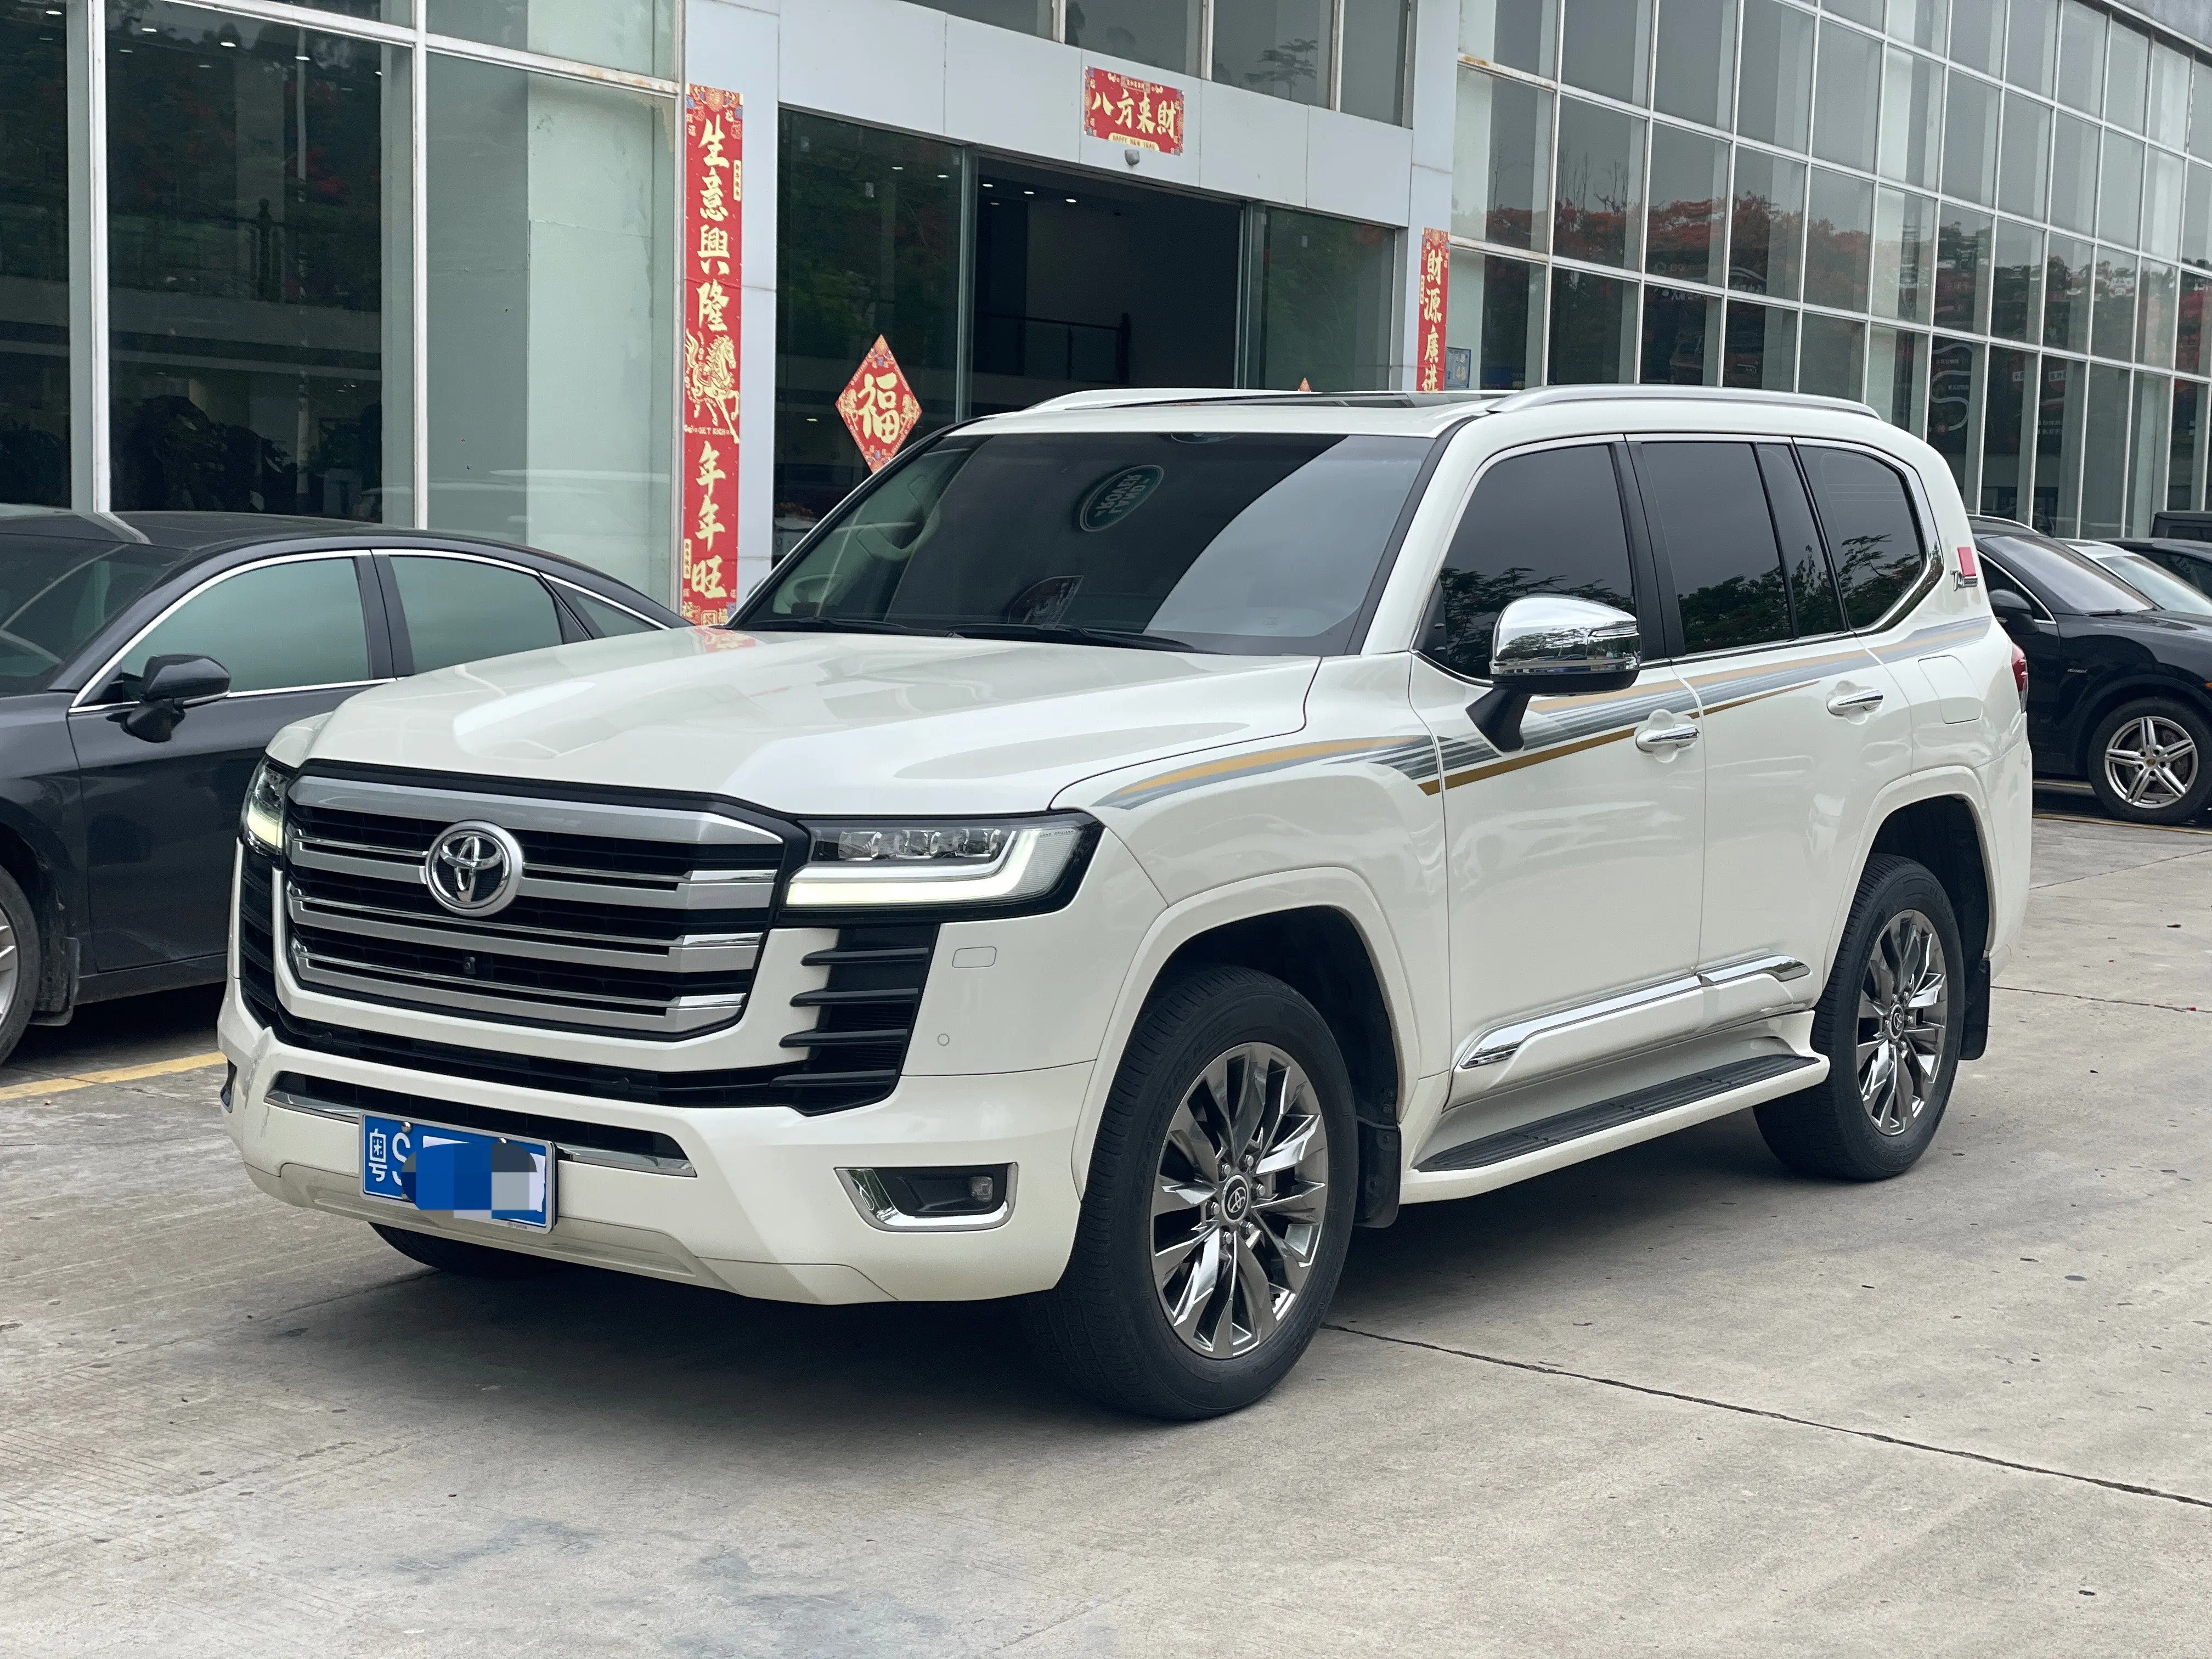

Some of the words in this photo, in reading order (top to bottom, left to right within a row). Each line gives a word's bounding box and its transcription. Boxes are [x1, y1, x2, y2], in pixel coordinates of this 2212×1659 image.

[1130, 138, 1141, 146] NEW
[857, 372, 900, 444] 福
[691, 440, 727, 599] 年年旺
